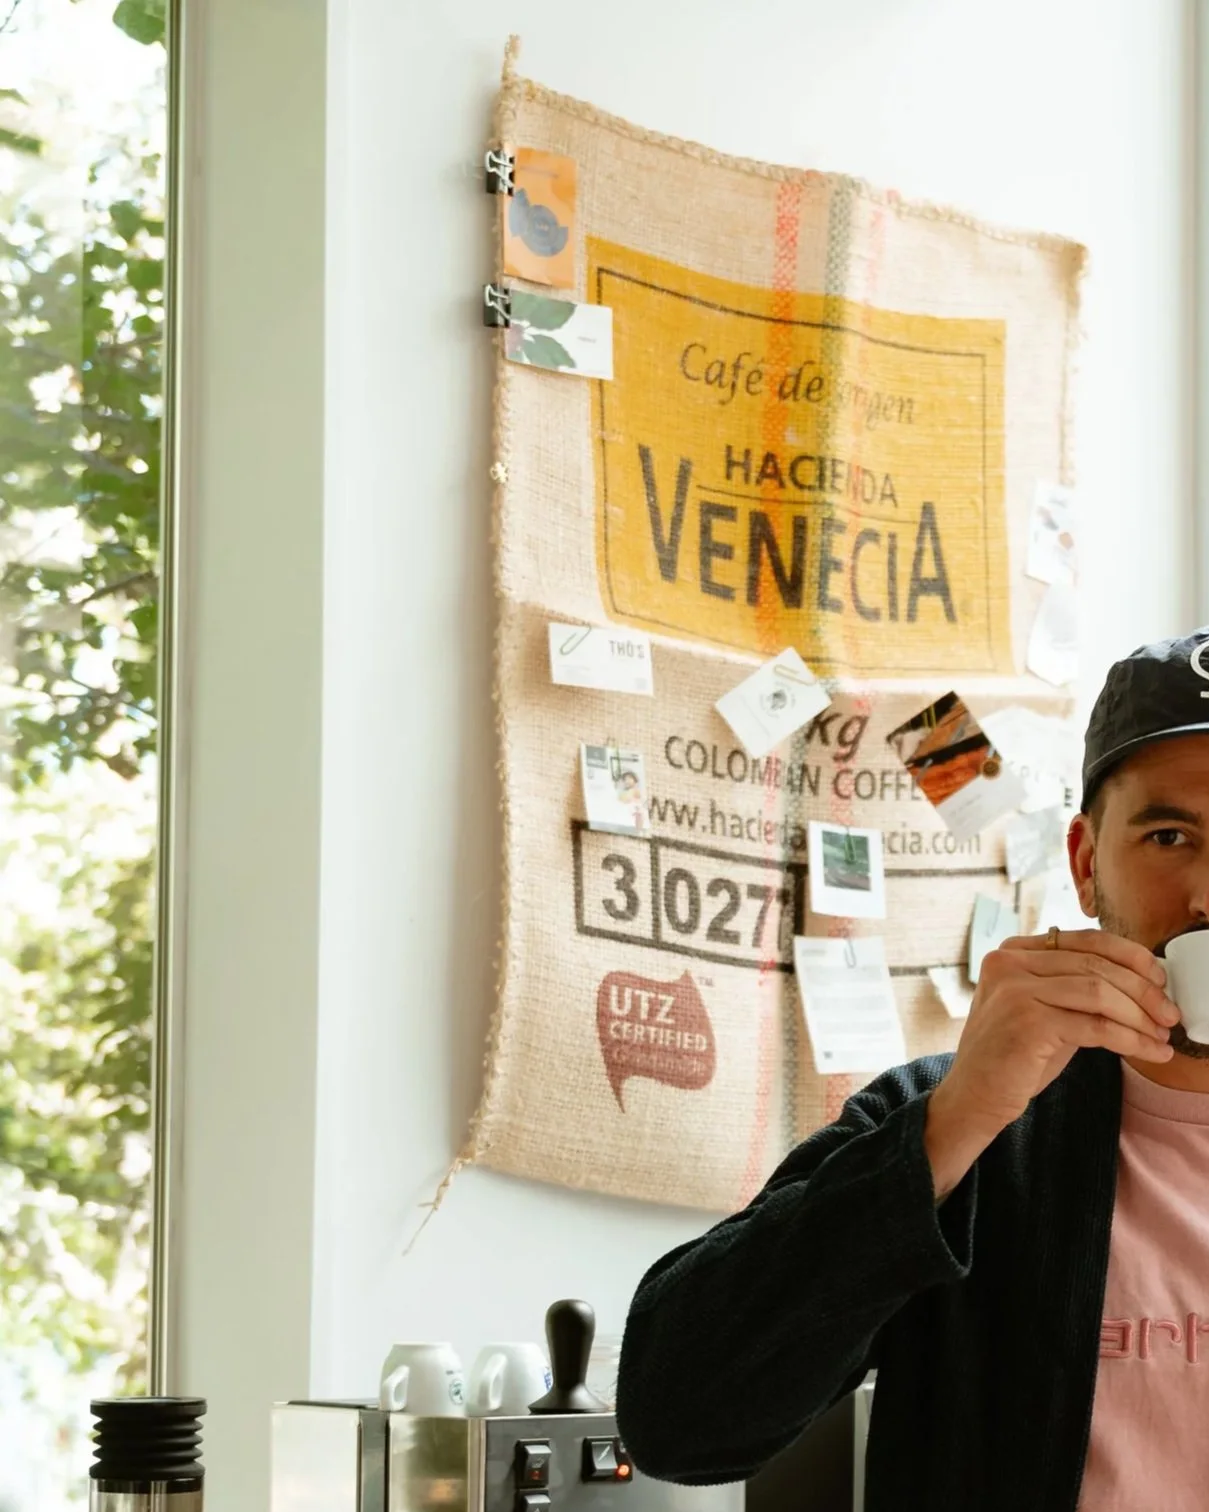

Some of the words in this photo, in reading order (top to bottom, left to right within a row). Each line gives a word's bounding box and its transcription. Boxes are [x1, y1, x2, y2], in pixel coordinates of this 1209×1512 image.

[680, 342, 766, 406] Café
[778, 359, 825, 404] de
[724, 443, 899, 509] HACIENDA
[638, 443, 958, 623] VENECIA
[600, 852, 640, 922] 3
[609, 984, 676, 1025] UTZ
[609, 1020, 708, 1053] CERTIFIED
